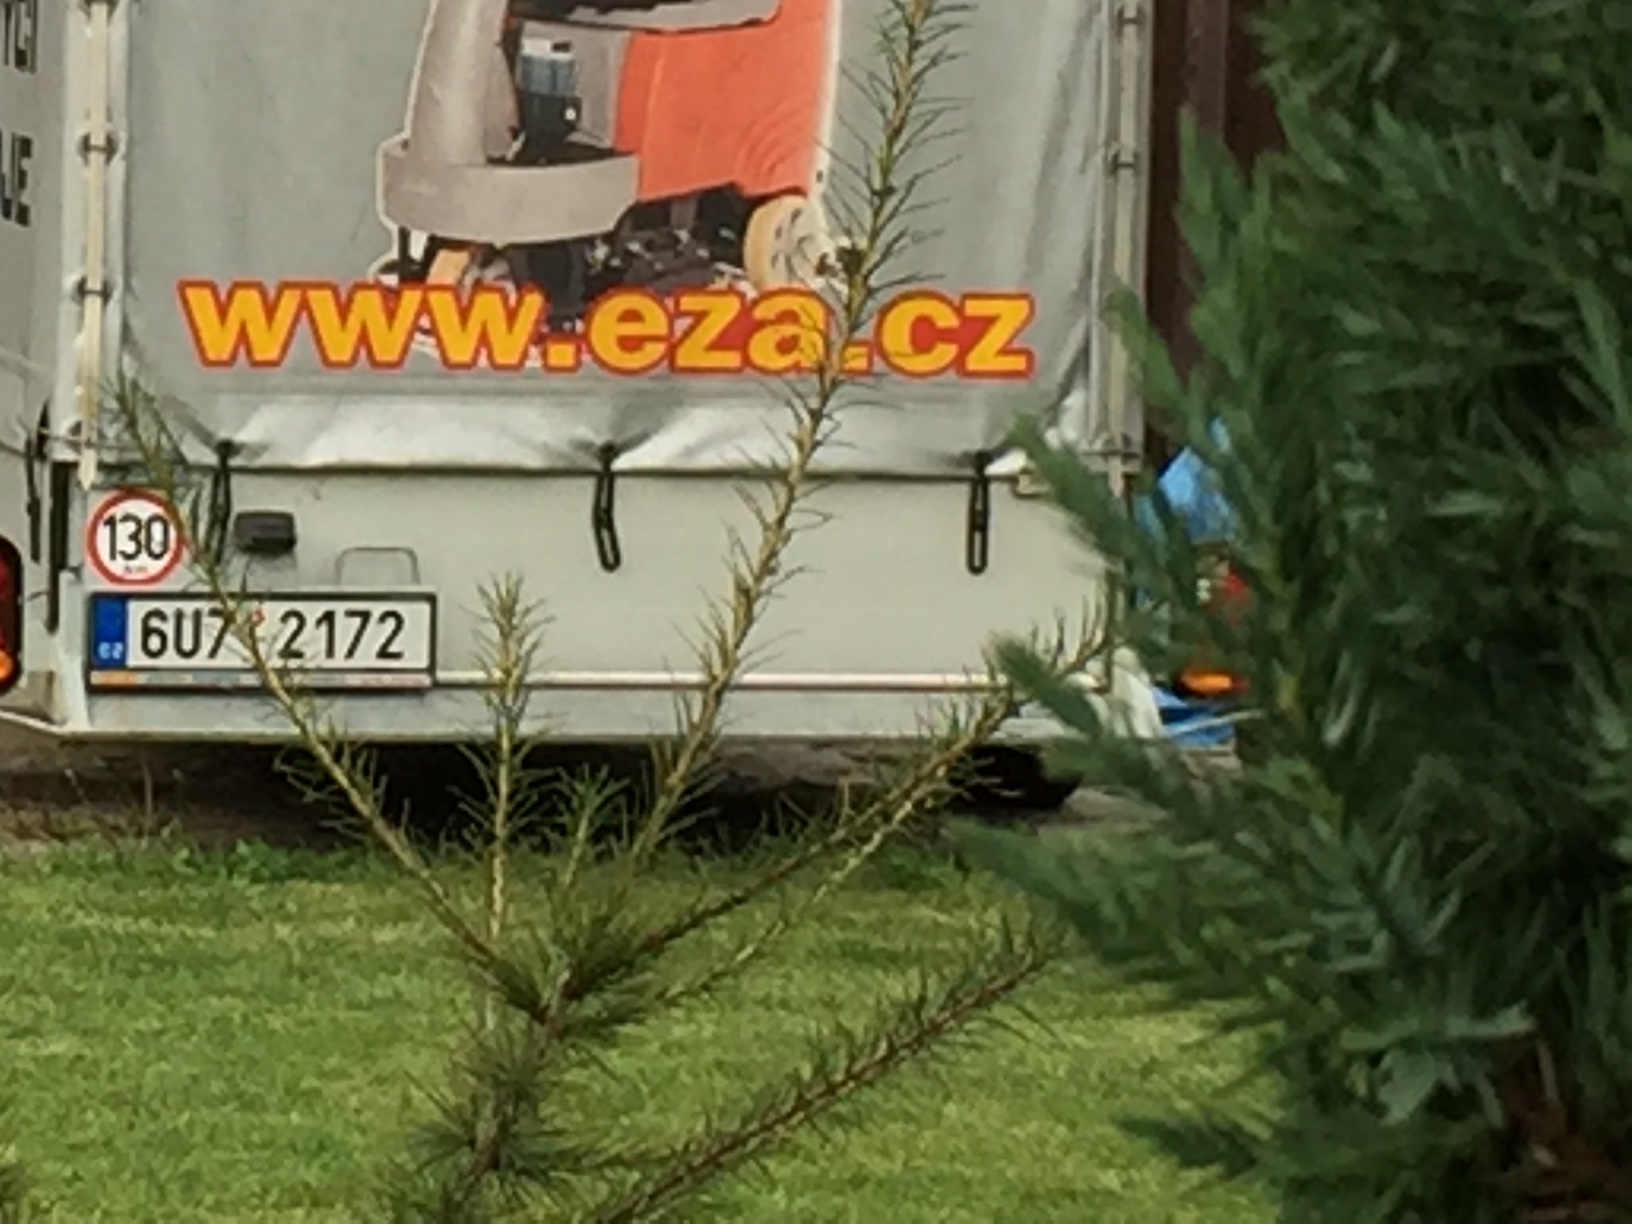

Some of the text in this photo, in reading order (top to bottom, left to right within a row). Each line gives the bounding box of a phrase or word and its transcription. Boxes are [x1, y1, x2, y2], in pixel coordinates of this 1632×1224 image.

[179, 281, 1034, 378] www.eza.cz
[104, 512, 169, 562] 130
[141, 609, 405, 660] 6U7 2172
